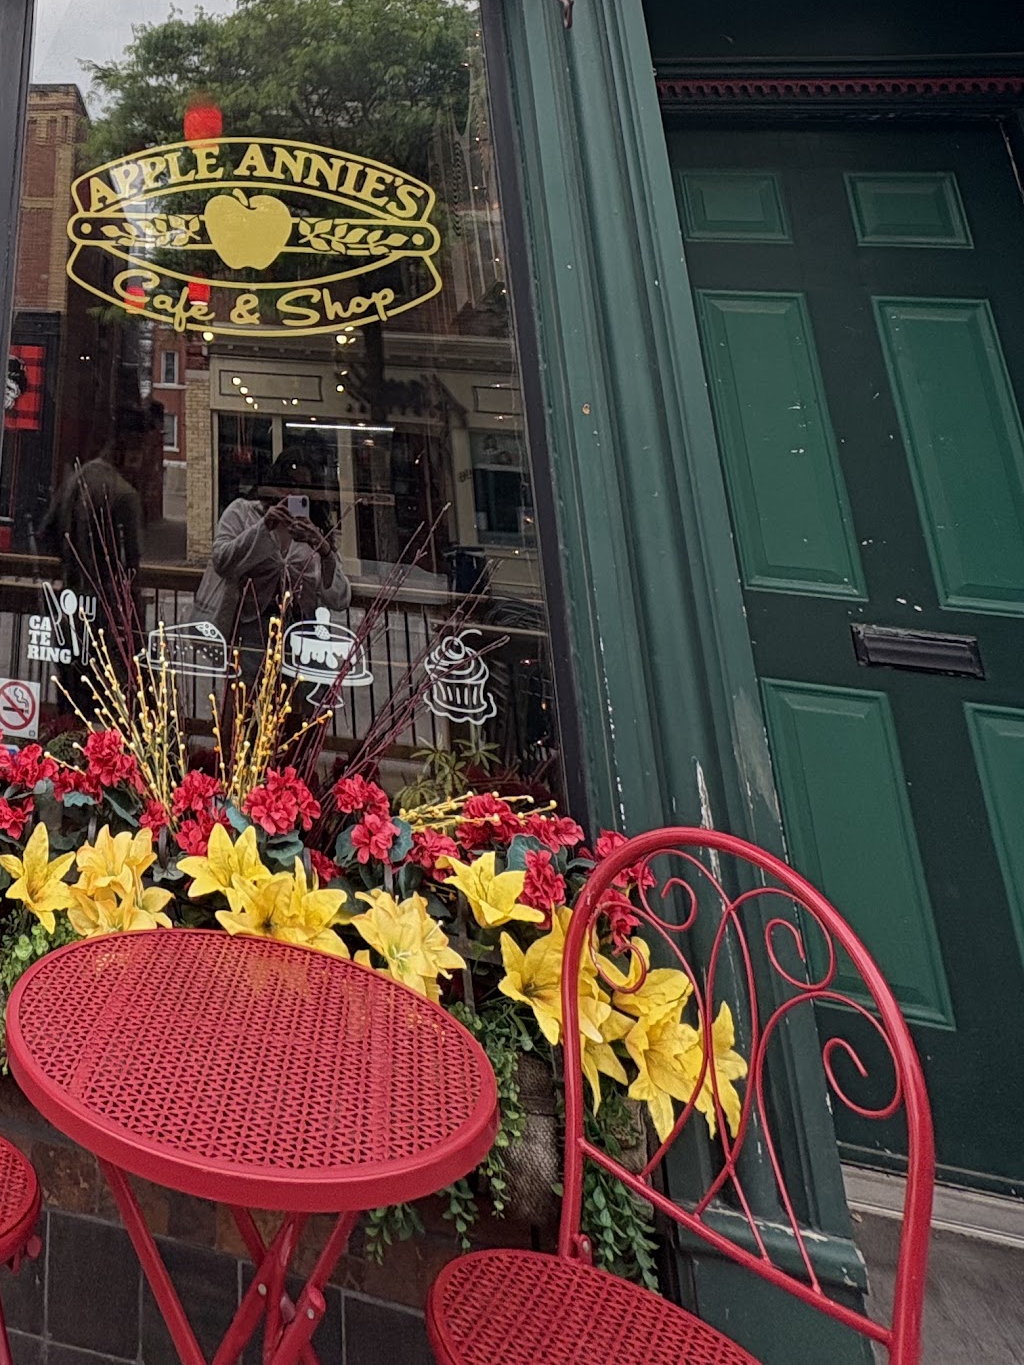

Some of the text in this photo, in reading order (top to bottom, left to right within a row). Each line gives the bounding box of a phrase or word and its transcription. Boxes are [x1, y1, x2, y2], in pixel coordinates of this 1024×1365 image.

[90, 143, 425, 218] APPLE ANNIE'S
[113, 268, 395, 332] Cafe & Shop
[27, 644, 72, 665] RING
